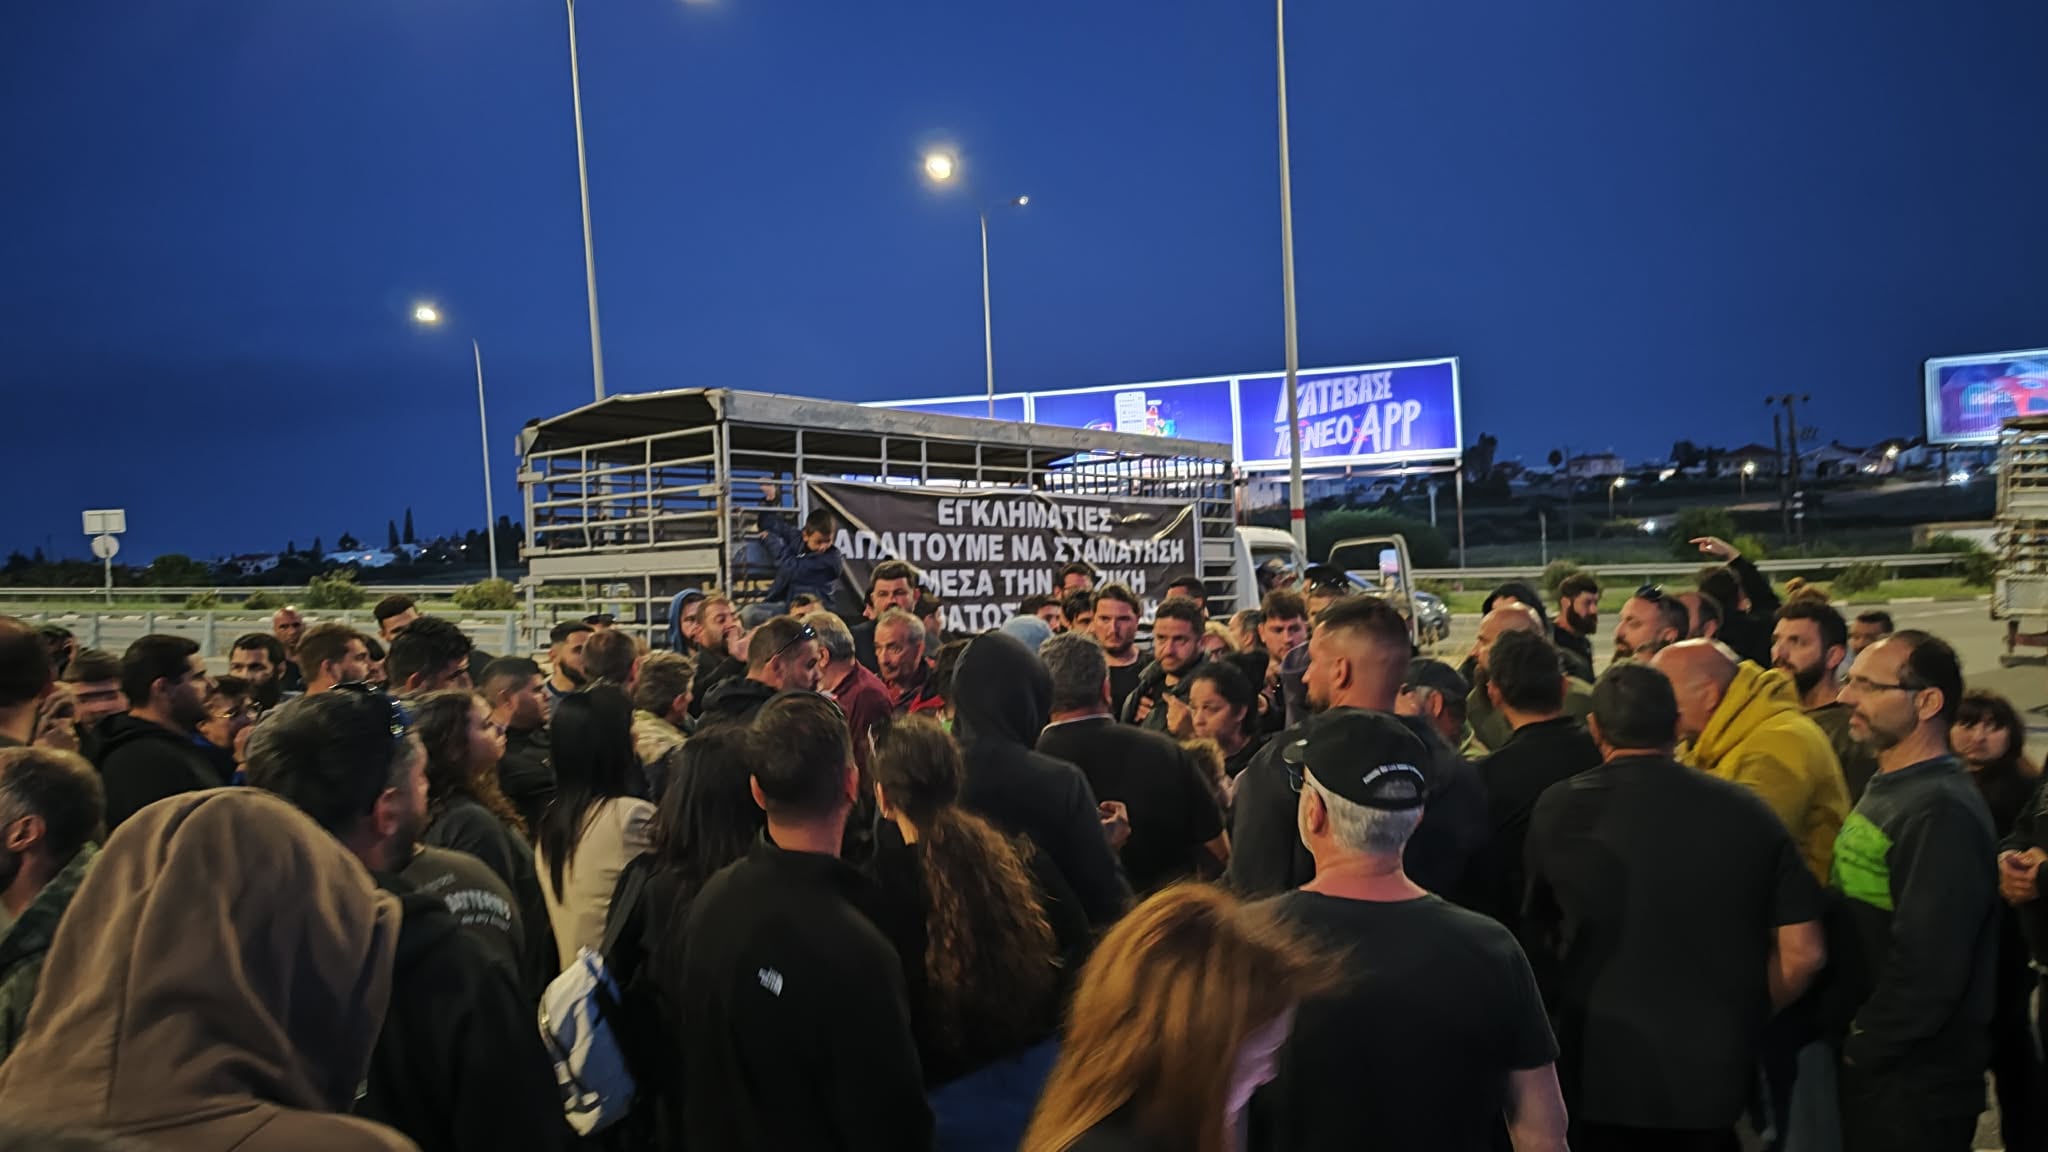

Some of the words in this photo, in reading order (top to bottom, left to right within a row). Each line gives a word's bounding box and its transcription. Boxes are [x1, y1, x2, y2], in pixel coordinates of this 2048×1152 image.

[1303, 415, 1354, 452] ΝΕΟ
[1350, 399, 1422, 456] APP
[938, 498, 1114, 533] ΕΓΚΛΗΜΑΤΙΕΣ
[834, 529, 1005, 562] ΑΠΑΙΤΟΥΜΕ
[1011, 534, 1048, 562] ΝΑ
[1053, 536, 1186, 564] ΣΤΑΜΑΤΗΣΗ
[918, 569, 995, 598] ΜΕΣΑ
[1000, 568, 1053, 597] ΤΗΝ
[1094, 569, 1146, 595] ΖΙΚΗ
